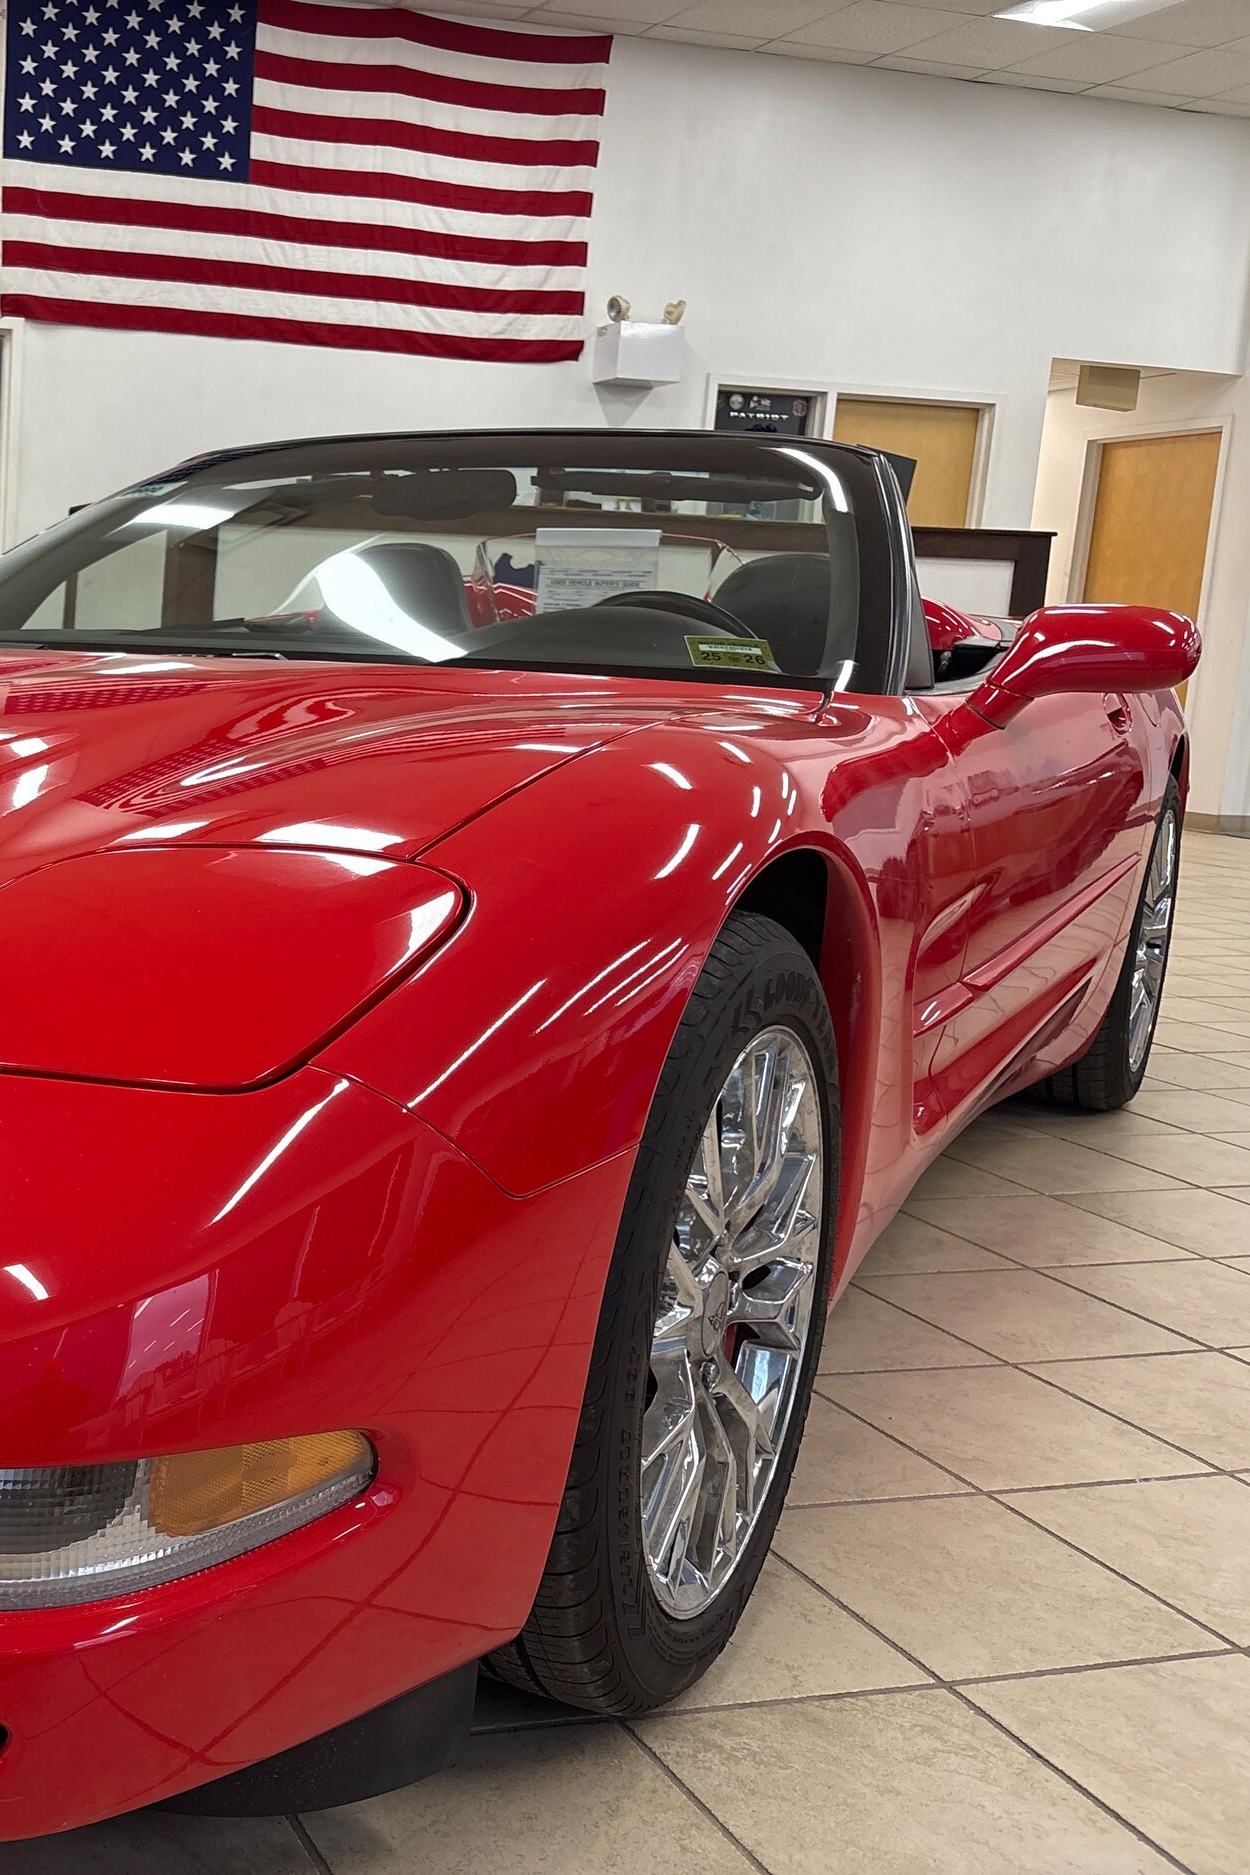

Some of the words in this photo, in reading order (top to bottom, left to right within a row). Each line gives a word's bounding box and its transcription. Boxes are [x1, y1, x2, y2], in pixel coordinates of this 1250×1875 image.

[729, 411, 789, 421] PATRIOT
[700, 652, 722, 661] 25
[743, 654, 766, 665] 26
